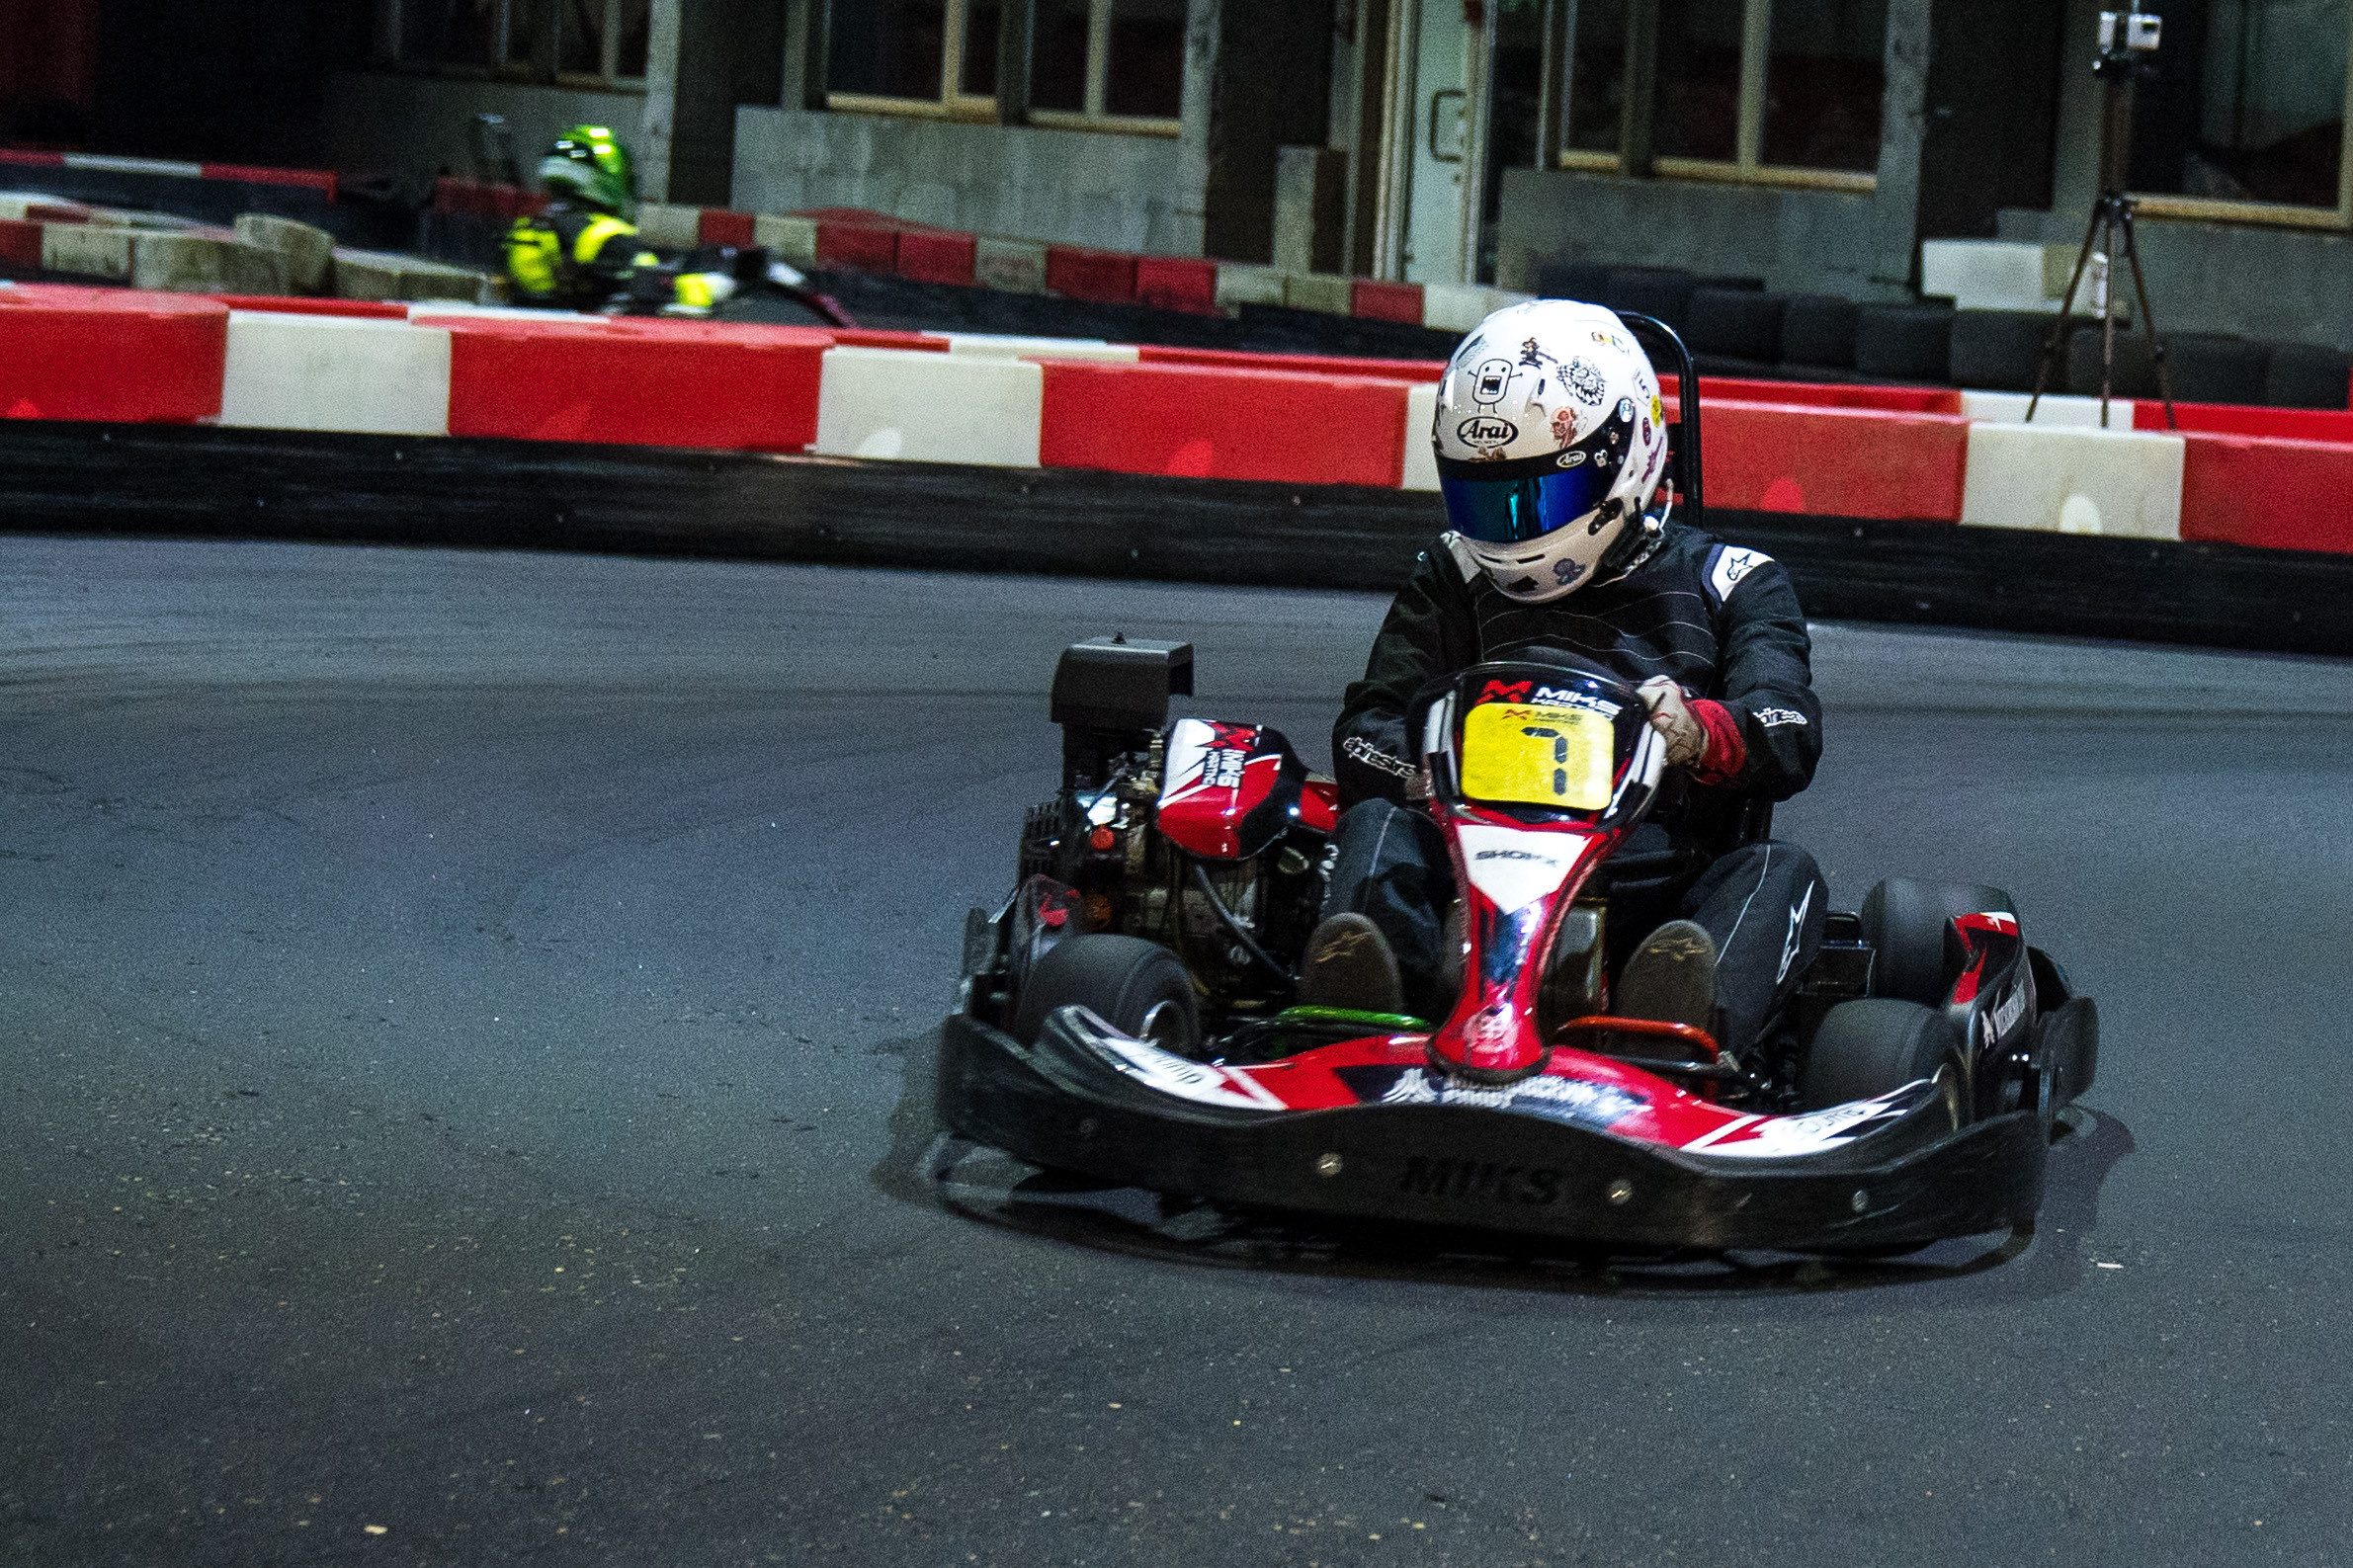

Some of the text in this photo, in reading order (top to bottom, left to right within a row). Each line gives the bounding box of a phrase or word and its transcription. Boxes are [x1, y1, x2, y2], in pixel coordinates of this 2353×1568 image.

[1461, 420, 1510, 439] Arai
[1560, 453, 1583, 465] Arai
[1536, 687, 1623, 715] MIKS
[1521, 726, 1568, 795] 7
